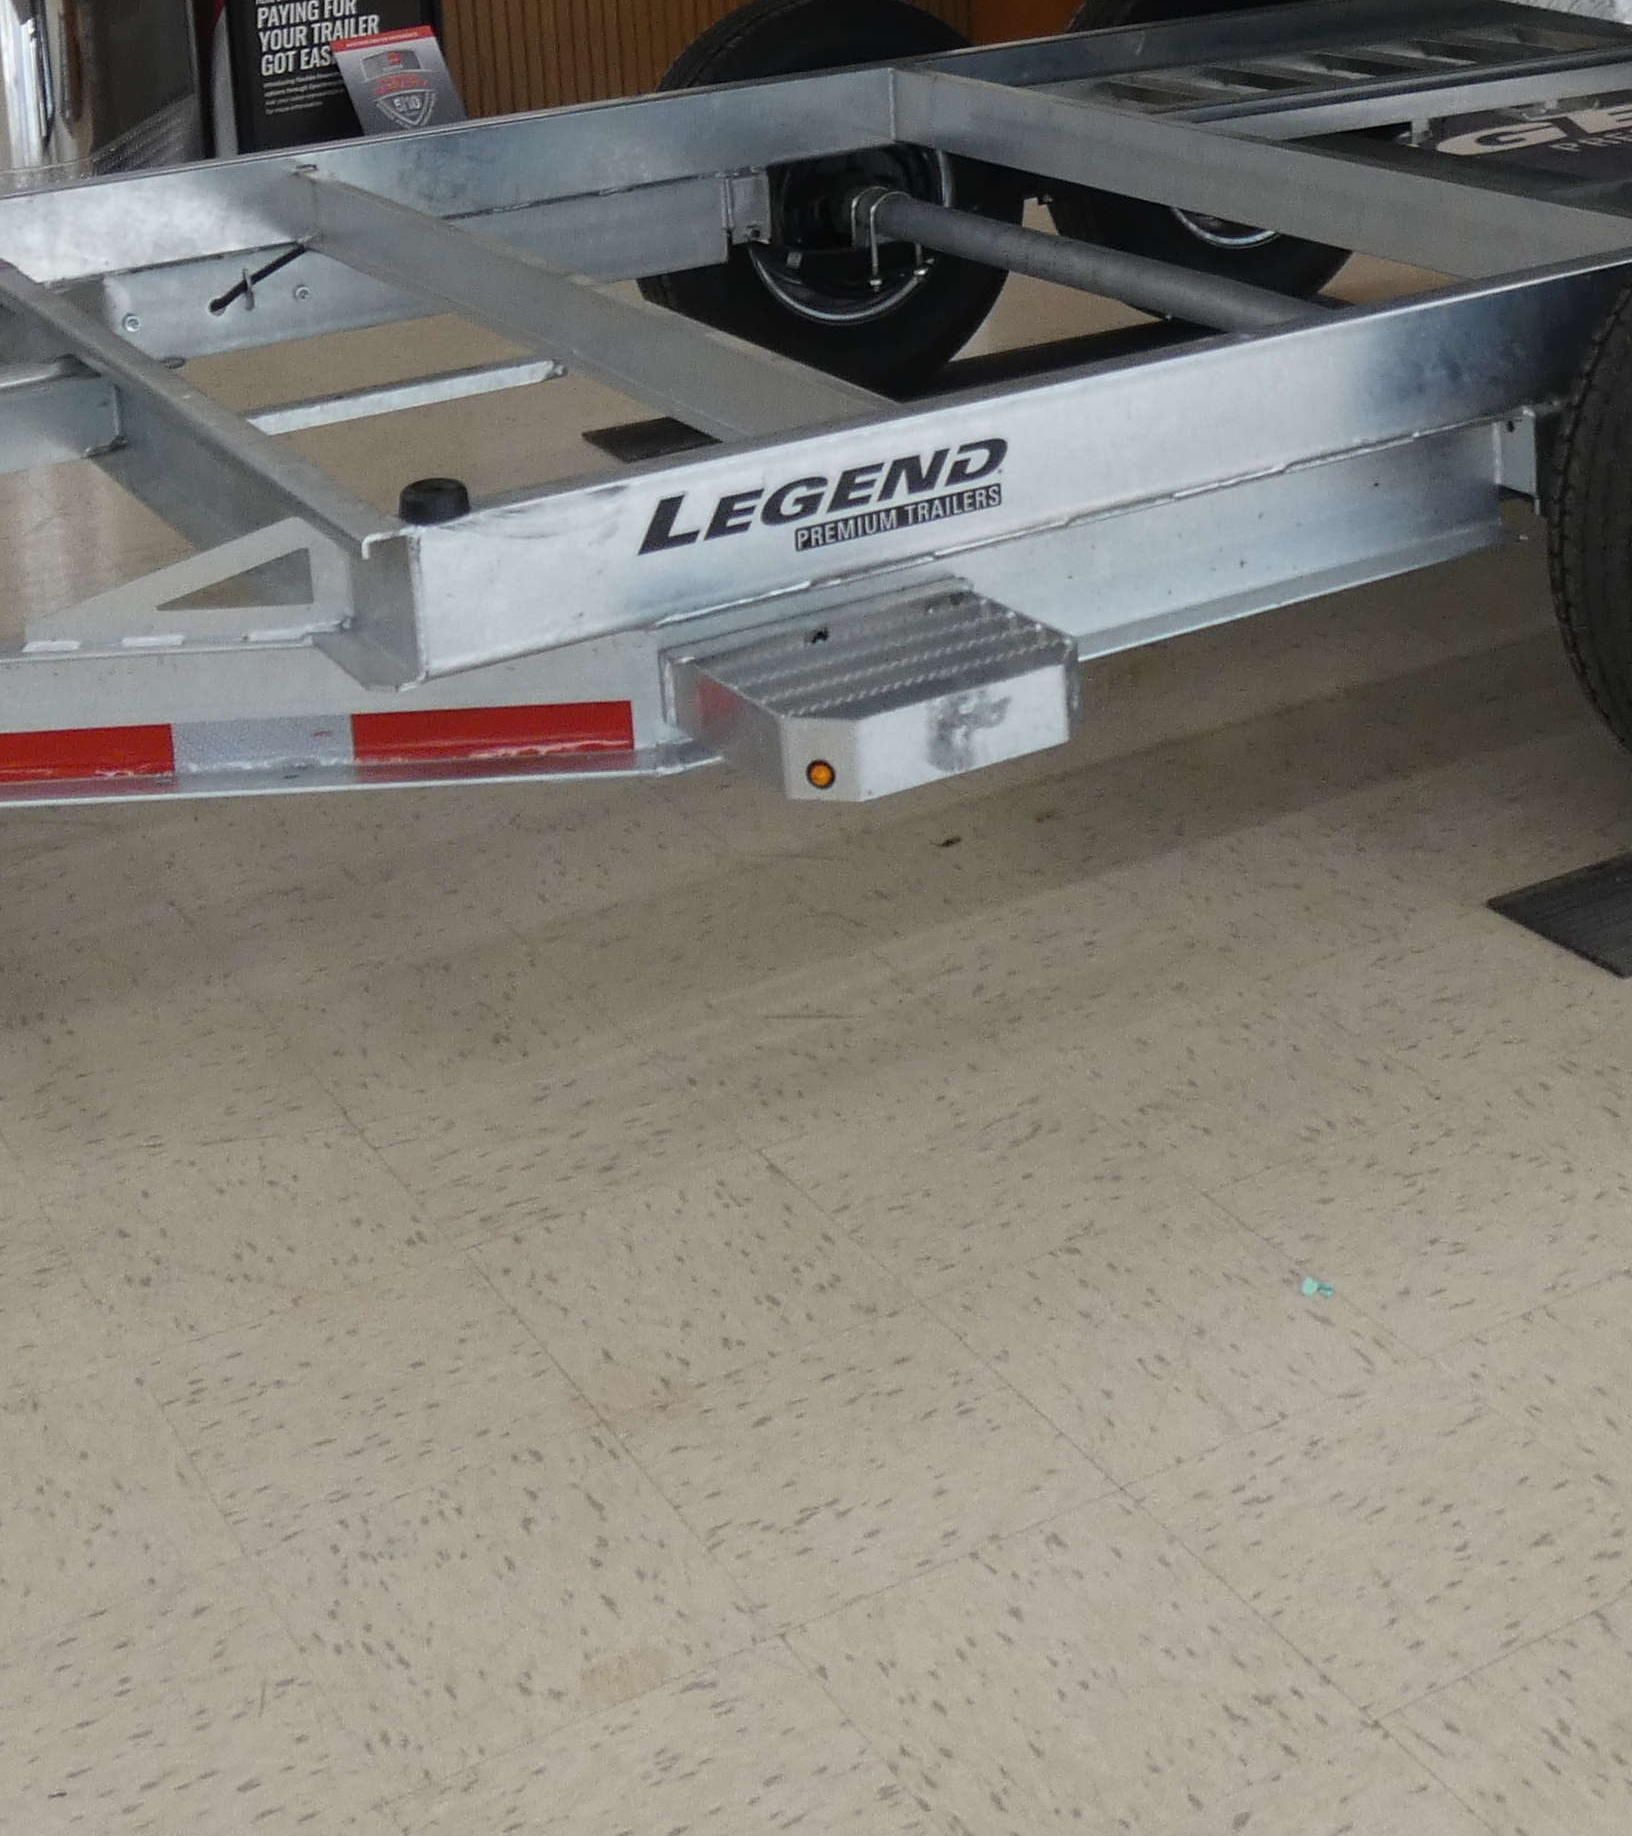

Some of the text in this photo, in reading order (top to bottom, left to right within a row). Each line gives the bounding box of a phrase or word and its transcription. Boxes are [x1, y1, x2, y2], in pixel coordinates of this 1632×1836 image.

[257, 0, 320, 29] PAYING
[259, 25, 308, 52] YOUR
[311, 14, 380, 44] TRAILER
[261, 50, 296, 76] GOT
[638, 437, 1008, 555] LEGEND
[796, 484, 1001, 551] PREMIUM TRAILERS
